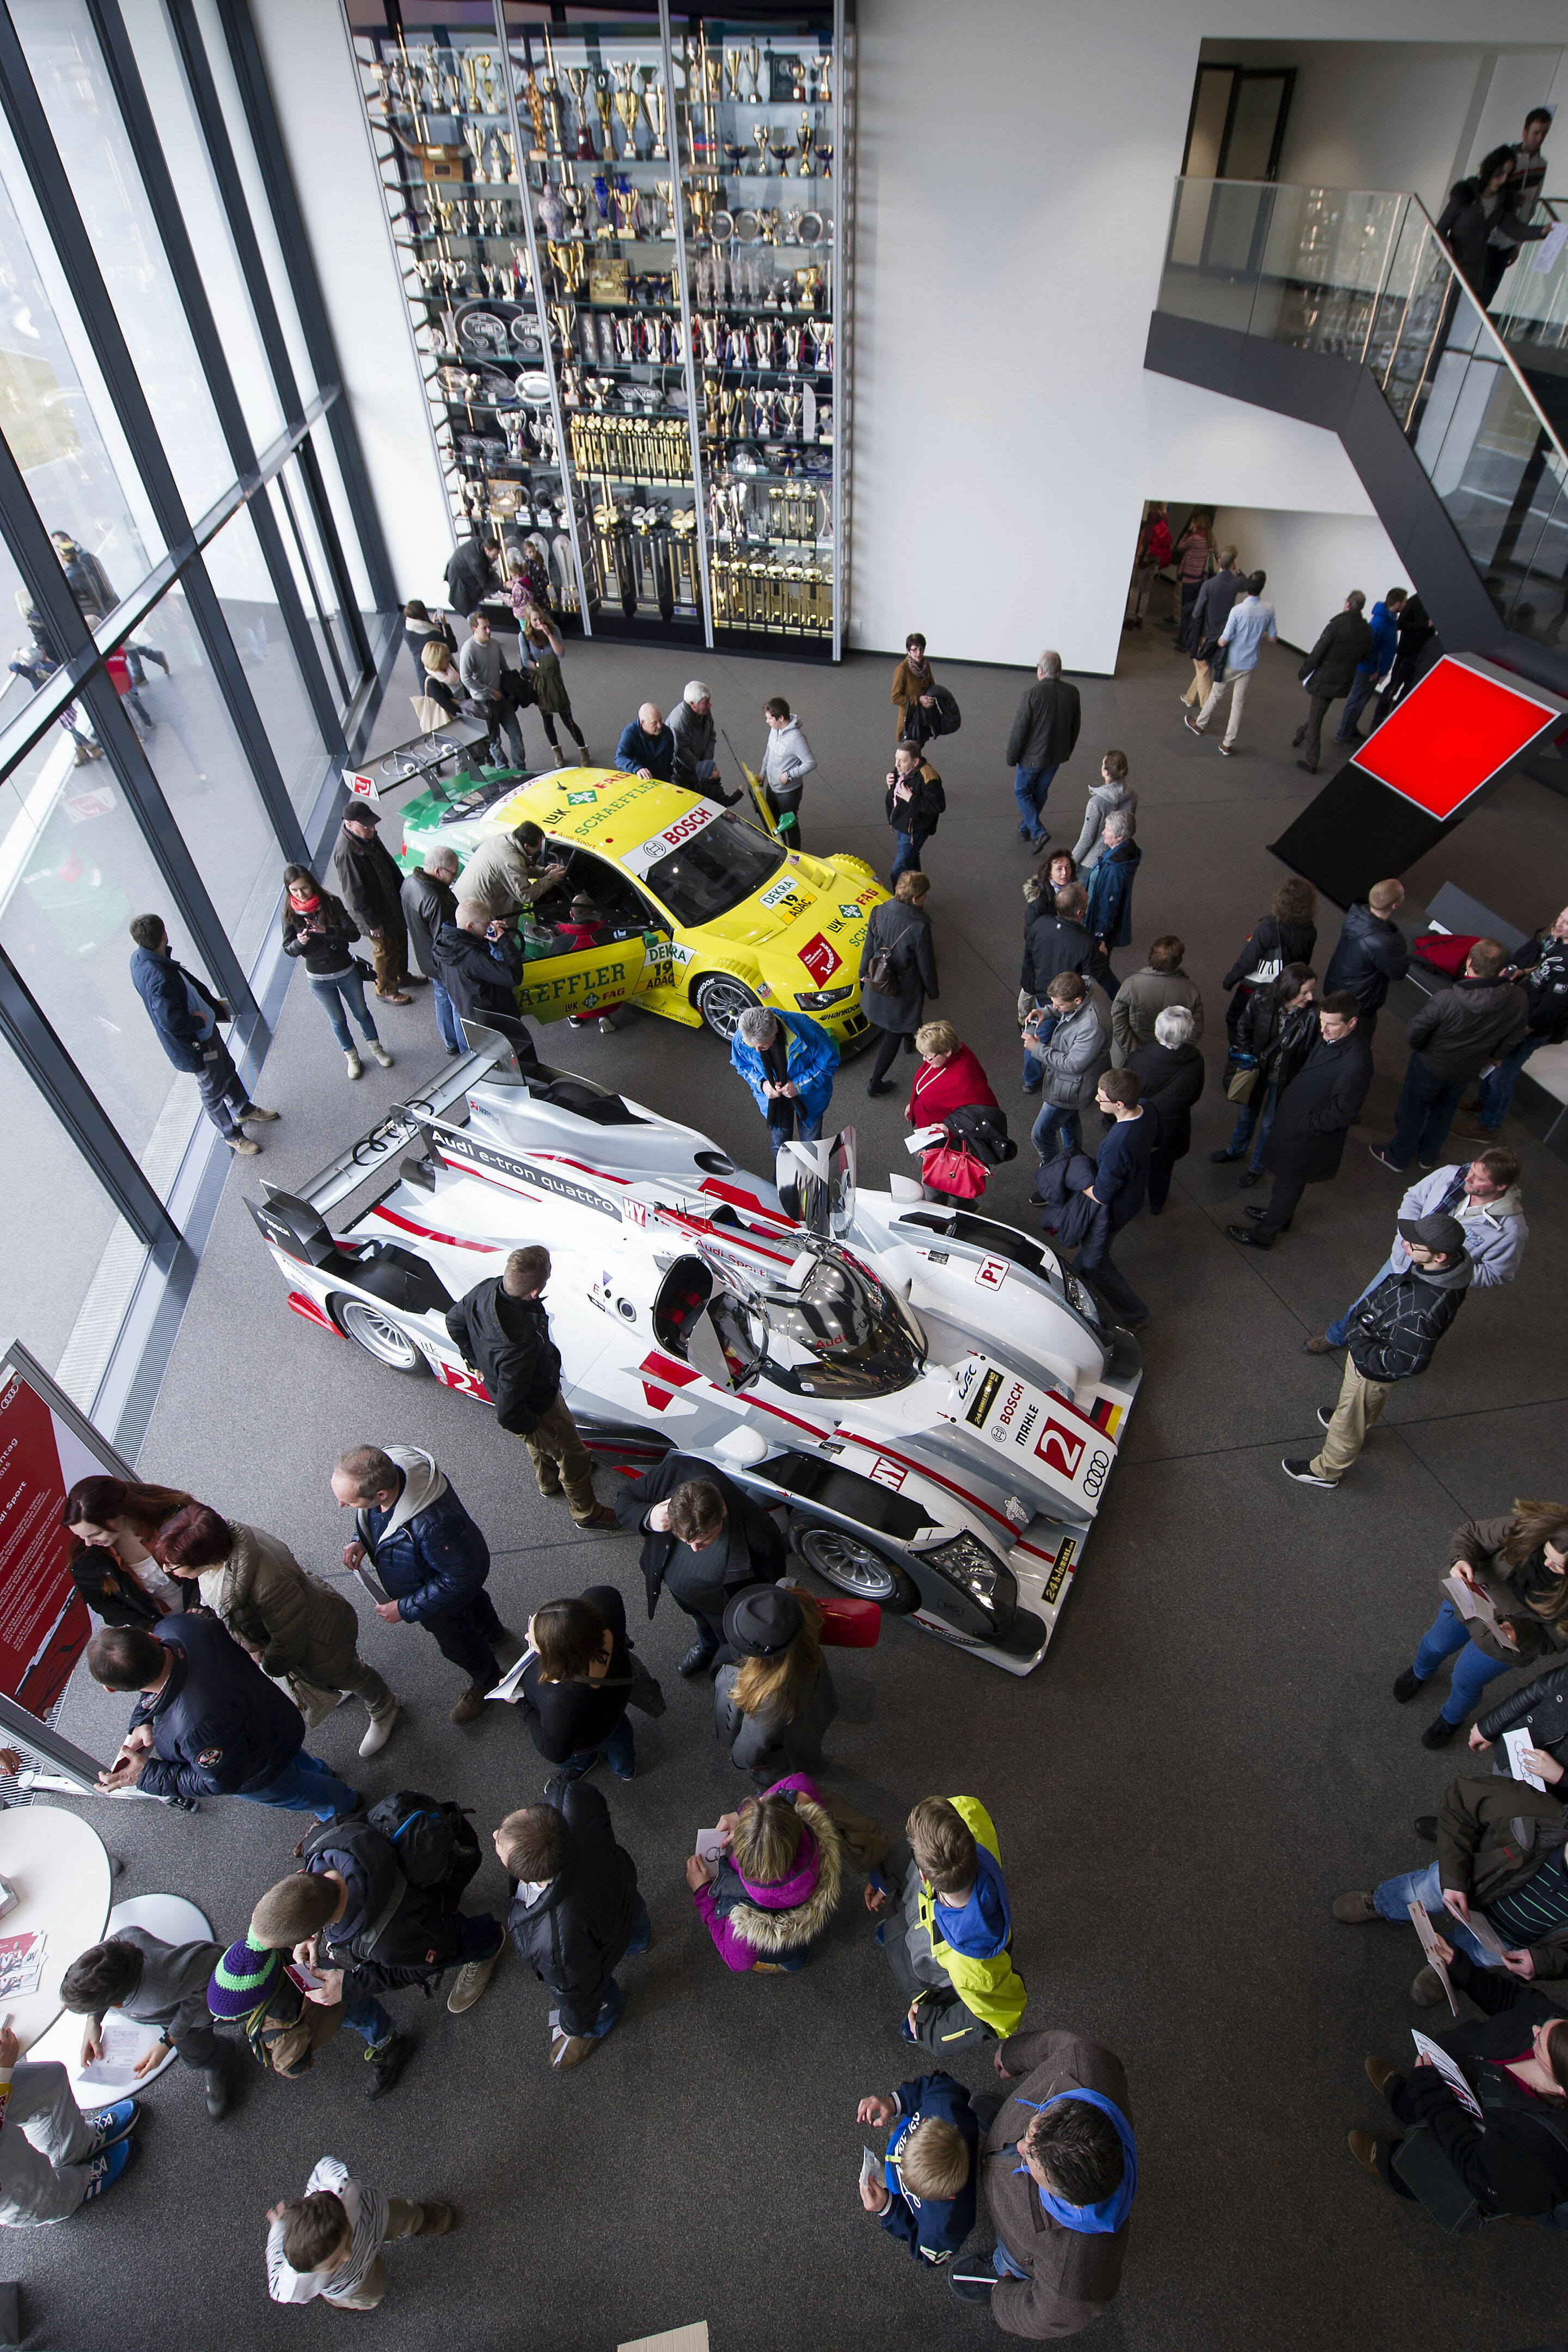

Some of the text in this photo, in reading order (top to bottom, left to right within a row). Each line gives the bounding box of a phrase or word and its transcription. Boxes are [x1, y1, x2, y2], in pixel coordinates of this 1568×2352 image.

[632, 506, 657, 524] 24
[671, 509, 696, 526] 24
[593, 773, 631, 789] FAG
[575, 780, 663, 835] SCHAEFFLER
[662, 807, 713, 845] BOSCH
[558, 832, 597, 849] Audi Sport
[763, 880, 795, 904] DEKRA
[780, 894, 799, 906] 19
[855, 889, 879, 906] FAG
[789, 899, 811, 917] ADAC
[654, 962, 672, 976] 19
[518, 963, 626, 1008] AEFFLER
[647, 974, 675, 989] ADAC
[603, 988, 624, 1000] FAG
[432, 1131, 615, 1212] Audi e-tron quattro
[695, 1239, 767, 1277] Audi Sport
[982, 1261, 1003, 1284] P1
[814, 1333, 848, 1350] Audi
[448, 1367, 479, 1398] 2
[959, 1364, 977, 1401] WEC
[1000, 1382, 1025, 1425] BOSCH
[972, 1412, 983, 1424] 24
[1015, 1404, 1039, 1446] MAHLE
[0, 1438, 18, 1468] ntag
[1040, 1429, 1082, 1472] 2
[0, 1462, 11, 1481] 015
[6, 1480, 27, 1510] Sport
[935, 1628, 976, 1644] MICHELIN
